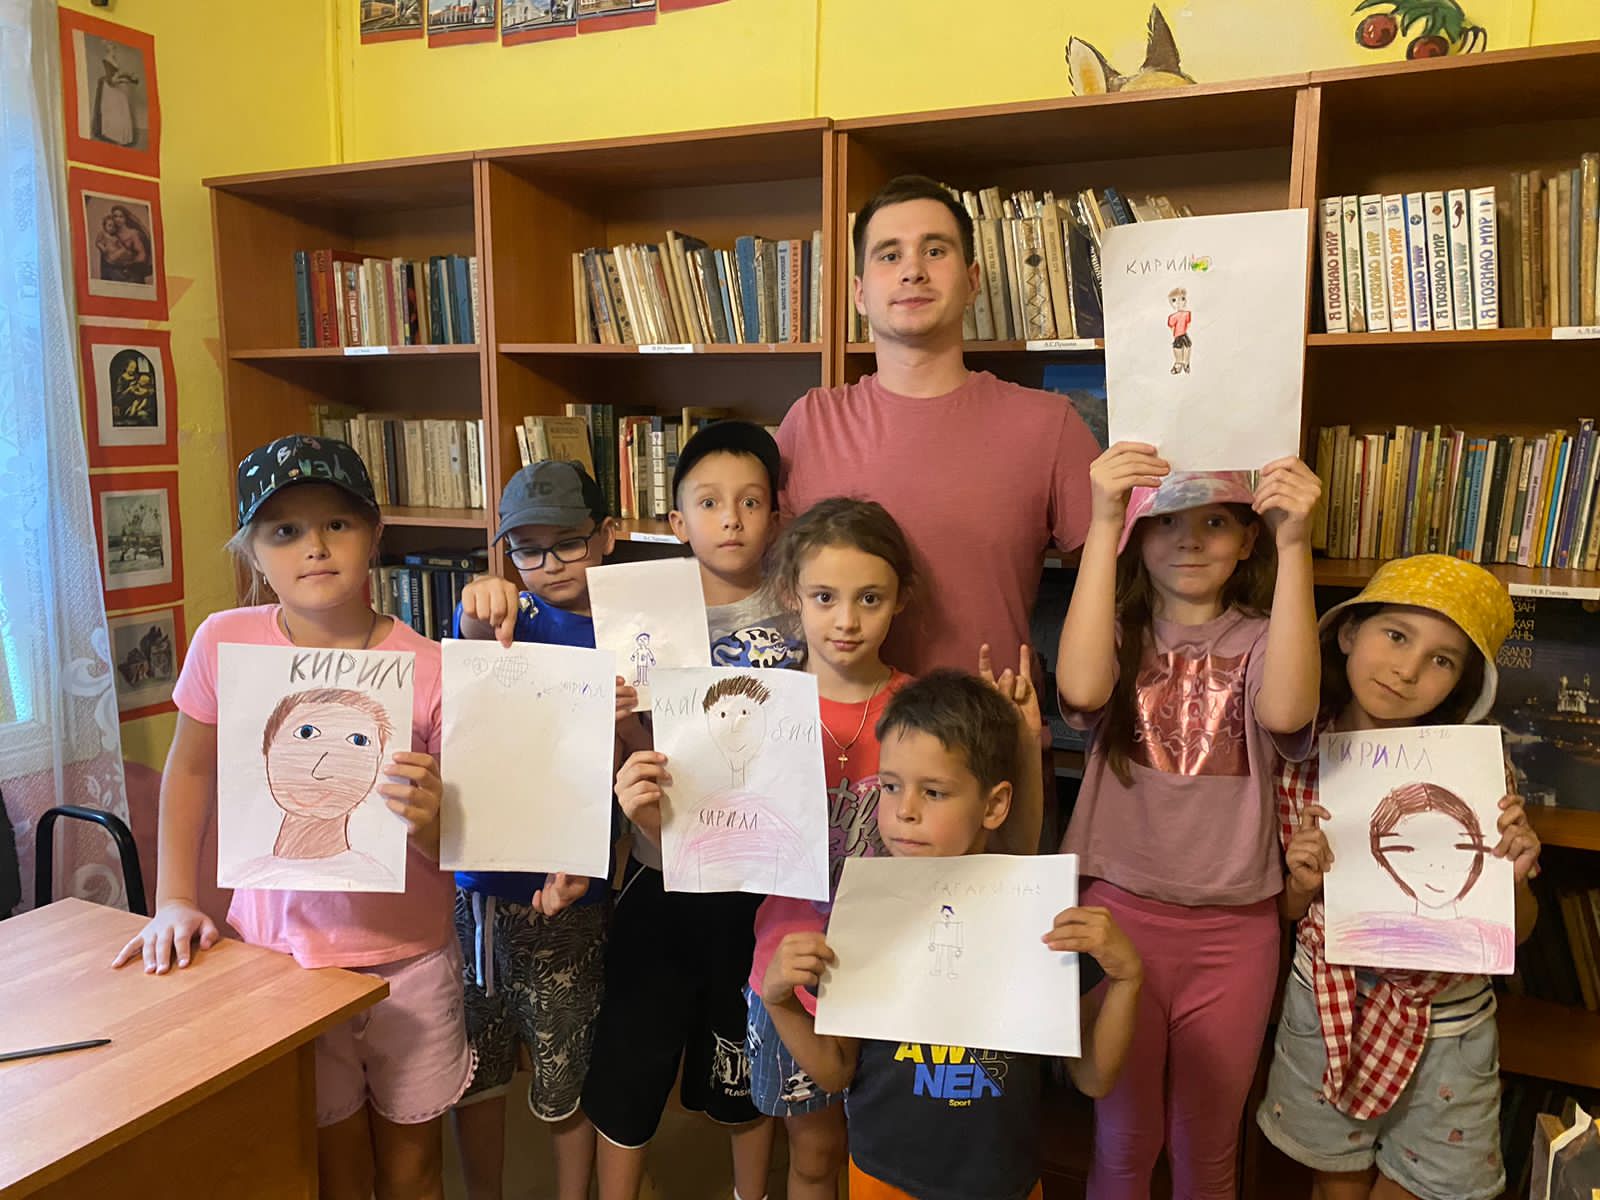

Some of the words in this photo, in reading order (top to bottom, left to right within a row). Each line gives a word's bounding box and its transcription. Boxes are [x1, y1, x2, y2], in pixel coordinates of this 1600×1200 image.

[1326, 231, 1339, 257] МИР
[1367, 231, 1381, 257] МИР
[1479, 217, 1493, 245] МИР
[1433, 233, 1445, 258] МИР
[1327, 259, 1341, 309] ПОЗНАЮ
[1368, 259, 1384, 310] ПОЗНАЮ
[1434, 260, 1448, 308] ПОЗНАЮ
[1480, 249, 1496, 305] ПОЗНАЮ
[1329, 310, 1342, 320] Я
[1371, 310, 1384, 320] Я
[1436, 309, 1449, 319] Я
[1481, 308, 1497, 320] Я
